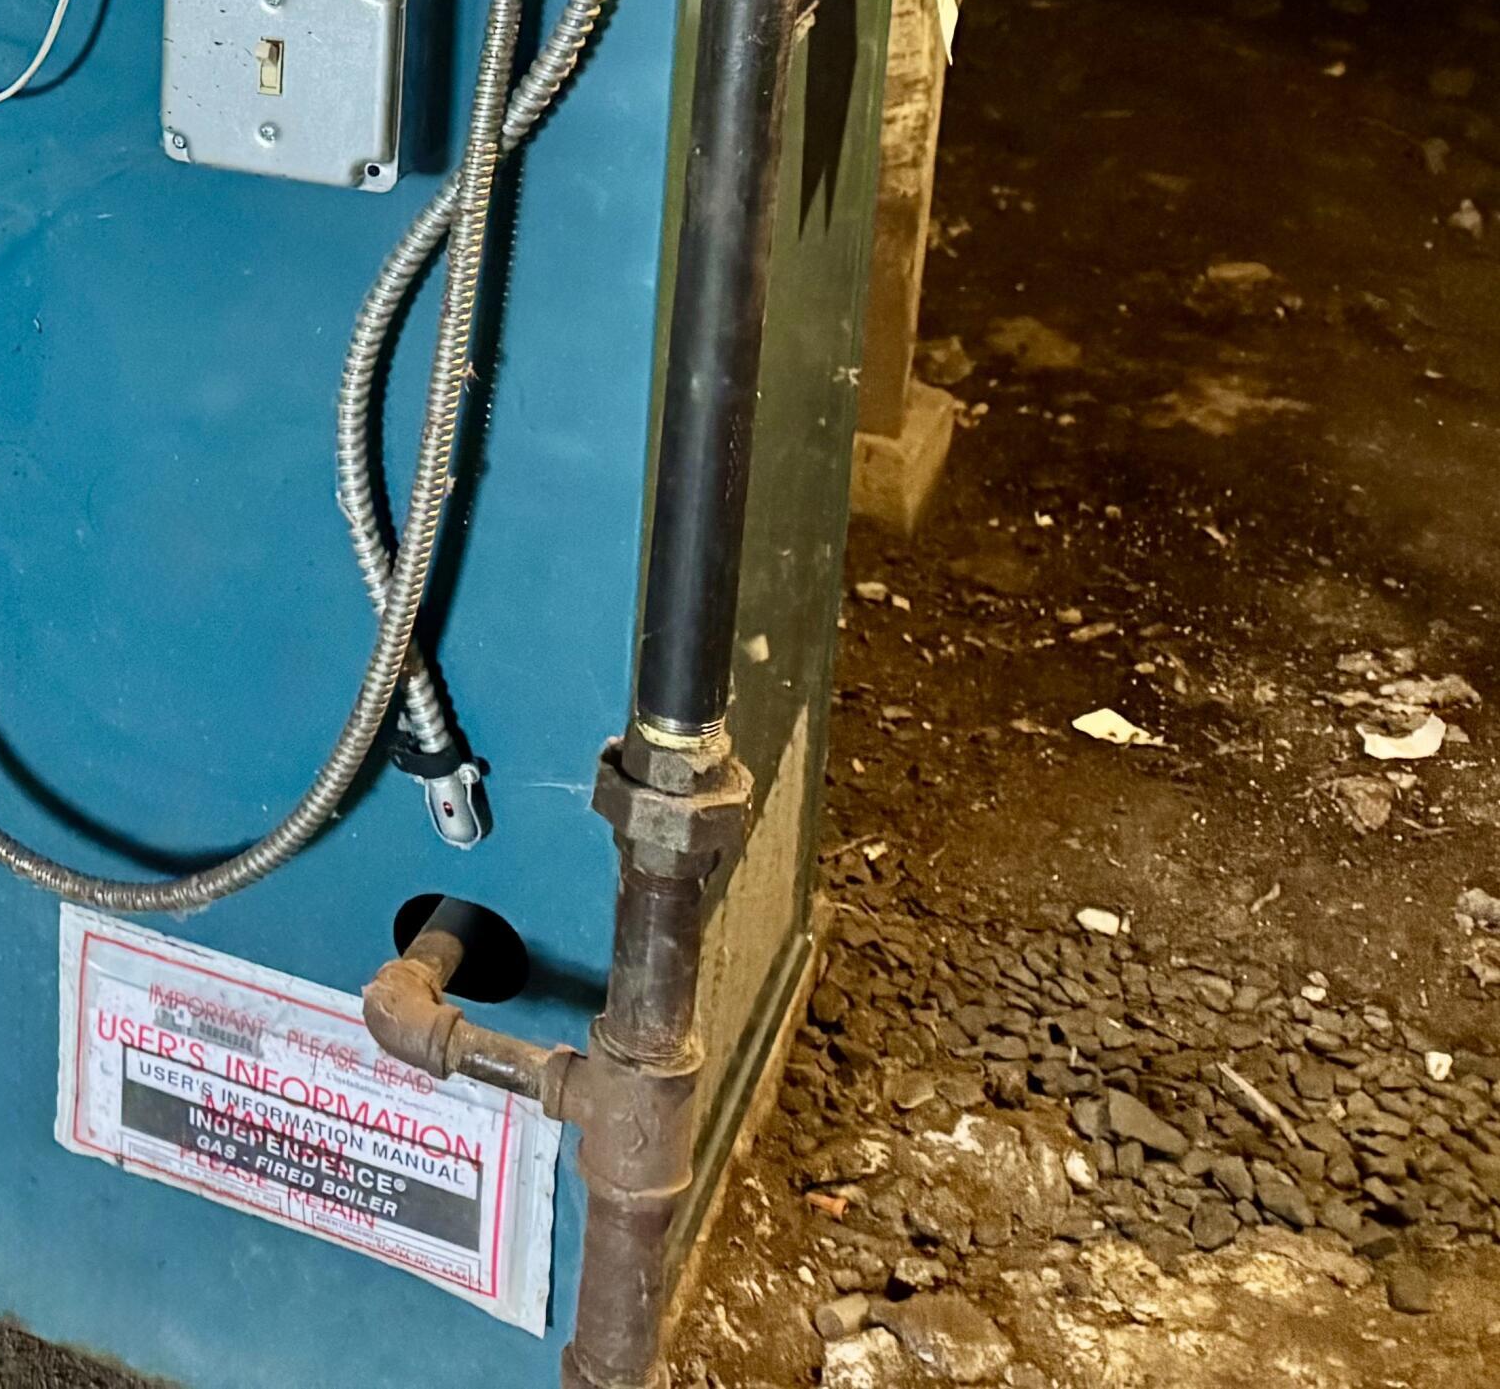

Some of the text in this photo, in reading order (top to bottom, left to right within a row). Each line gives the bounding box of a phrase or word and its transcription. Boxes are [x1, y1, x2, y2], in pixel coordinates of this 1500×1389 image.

[98, 1007, 205, 1072] USER'S
[226, 1055, 482, 1172] INFORMATION
[149, 983, 266, 1038] IMPORTANT
[287, 1029, 362, 1071] PLEASE
[373, 1058, 433, 1095] READ
[139, 1060, 213, 1097] USER'S
[221, 1088, 363, 1151] INFORMATION
[373, 1141, 466, 1186] MANUAL
[197, 1135, 237, 1160] GAS
[256, 1155, 315, 1188] FIRED
[322, 1179, 398, 1217] BOILER
[288, 1187, 376, 1230] RETAIN
